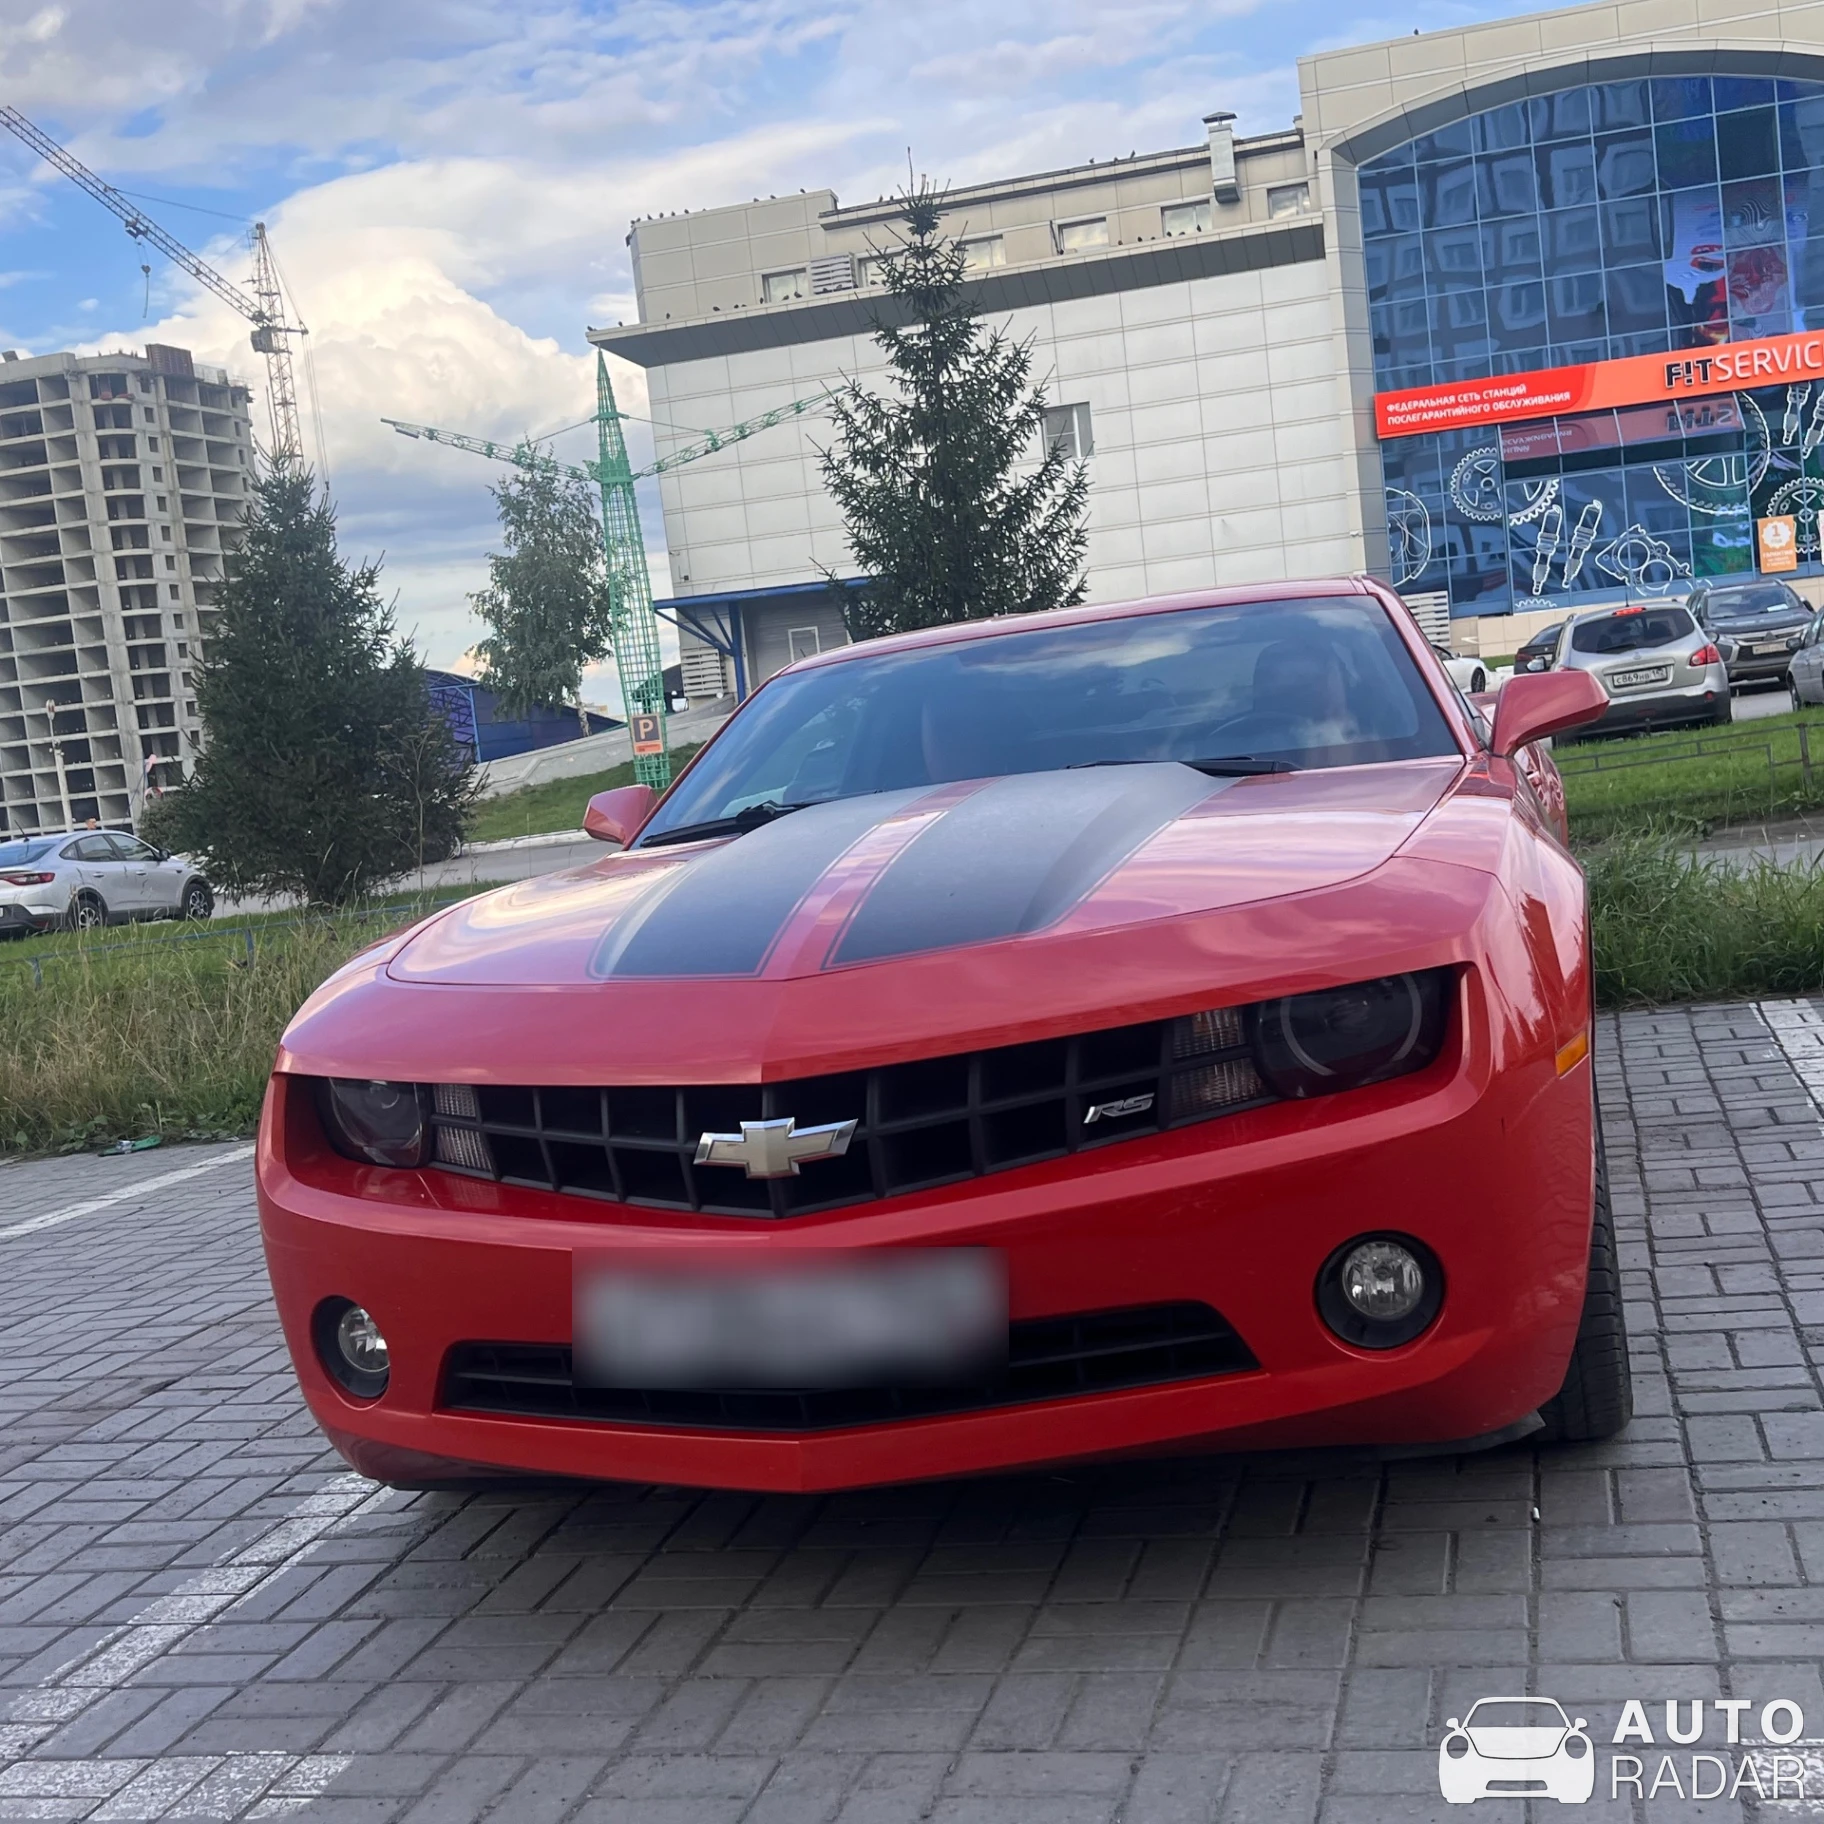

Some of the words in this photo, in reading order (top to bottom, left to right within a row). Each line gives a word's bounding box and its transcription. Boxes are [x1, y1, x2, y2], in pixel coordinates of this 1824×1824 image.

[1665, 340, 1824, 388] F!TSERVIC
[1386, 395, 1455, 412] ФЕДЕРАЛЬНАЯ
[1457, 392, 1480, 404] СЕТЬ
[1483, 384, 1526, 400] СТАНЦИЙ
[1387, 403, 1490, 425] ПОСЛЕГАРАНТИЙНОГО
[1493, 391, 1570, 411] ОБСЛУЖИВАНИЯ
[639, 718, 654, 740] P
[1083, 1092, 1155, 1124] RS
